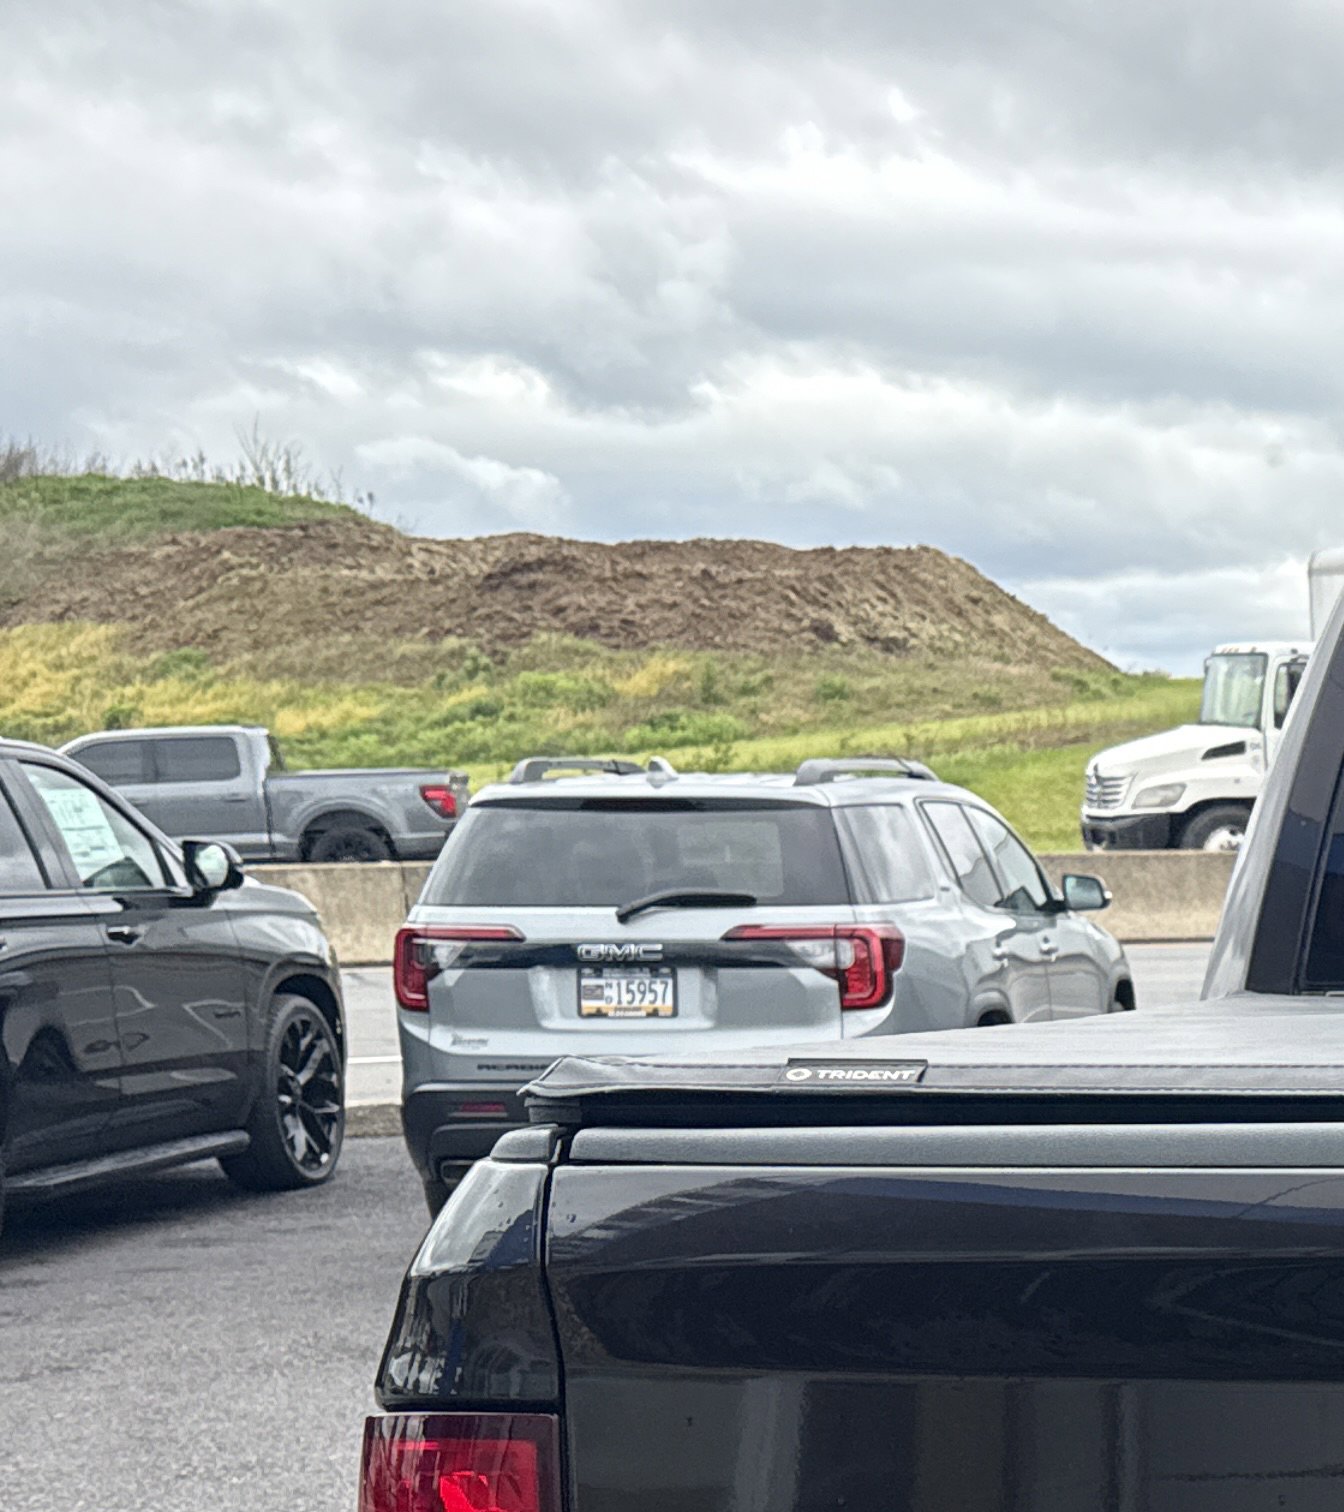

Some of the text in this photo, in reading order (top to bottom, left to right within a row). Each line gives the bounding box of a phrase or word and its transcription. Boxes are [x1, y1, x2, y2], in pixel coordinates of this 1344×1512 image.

[577, 943, 663, 961] GMC
[616, 980, 669, 1005] 15957
[817, 1069, 916, 1080] TRIDENT
